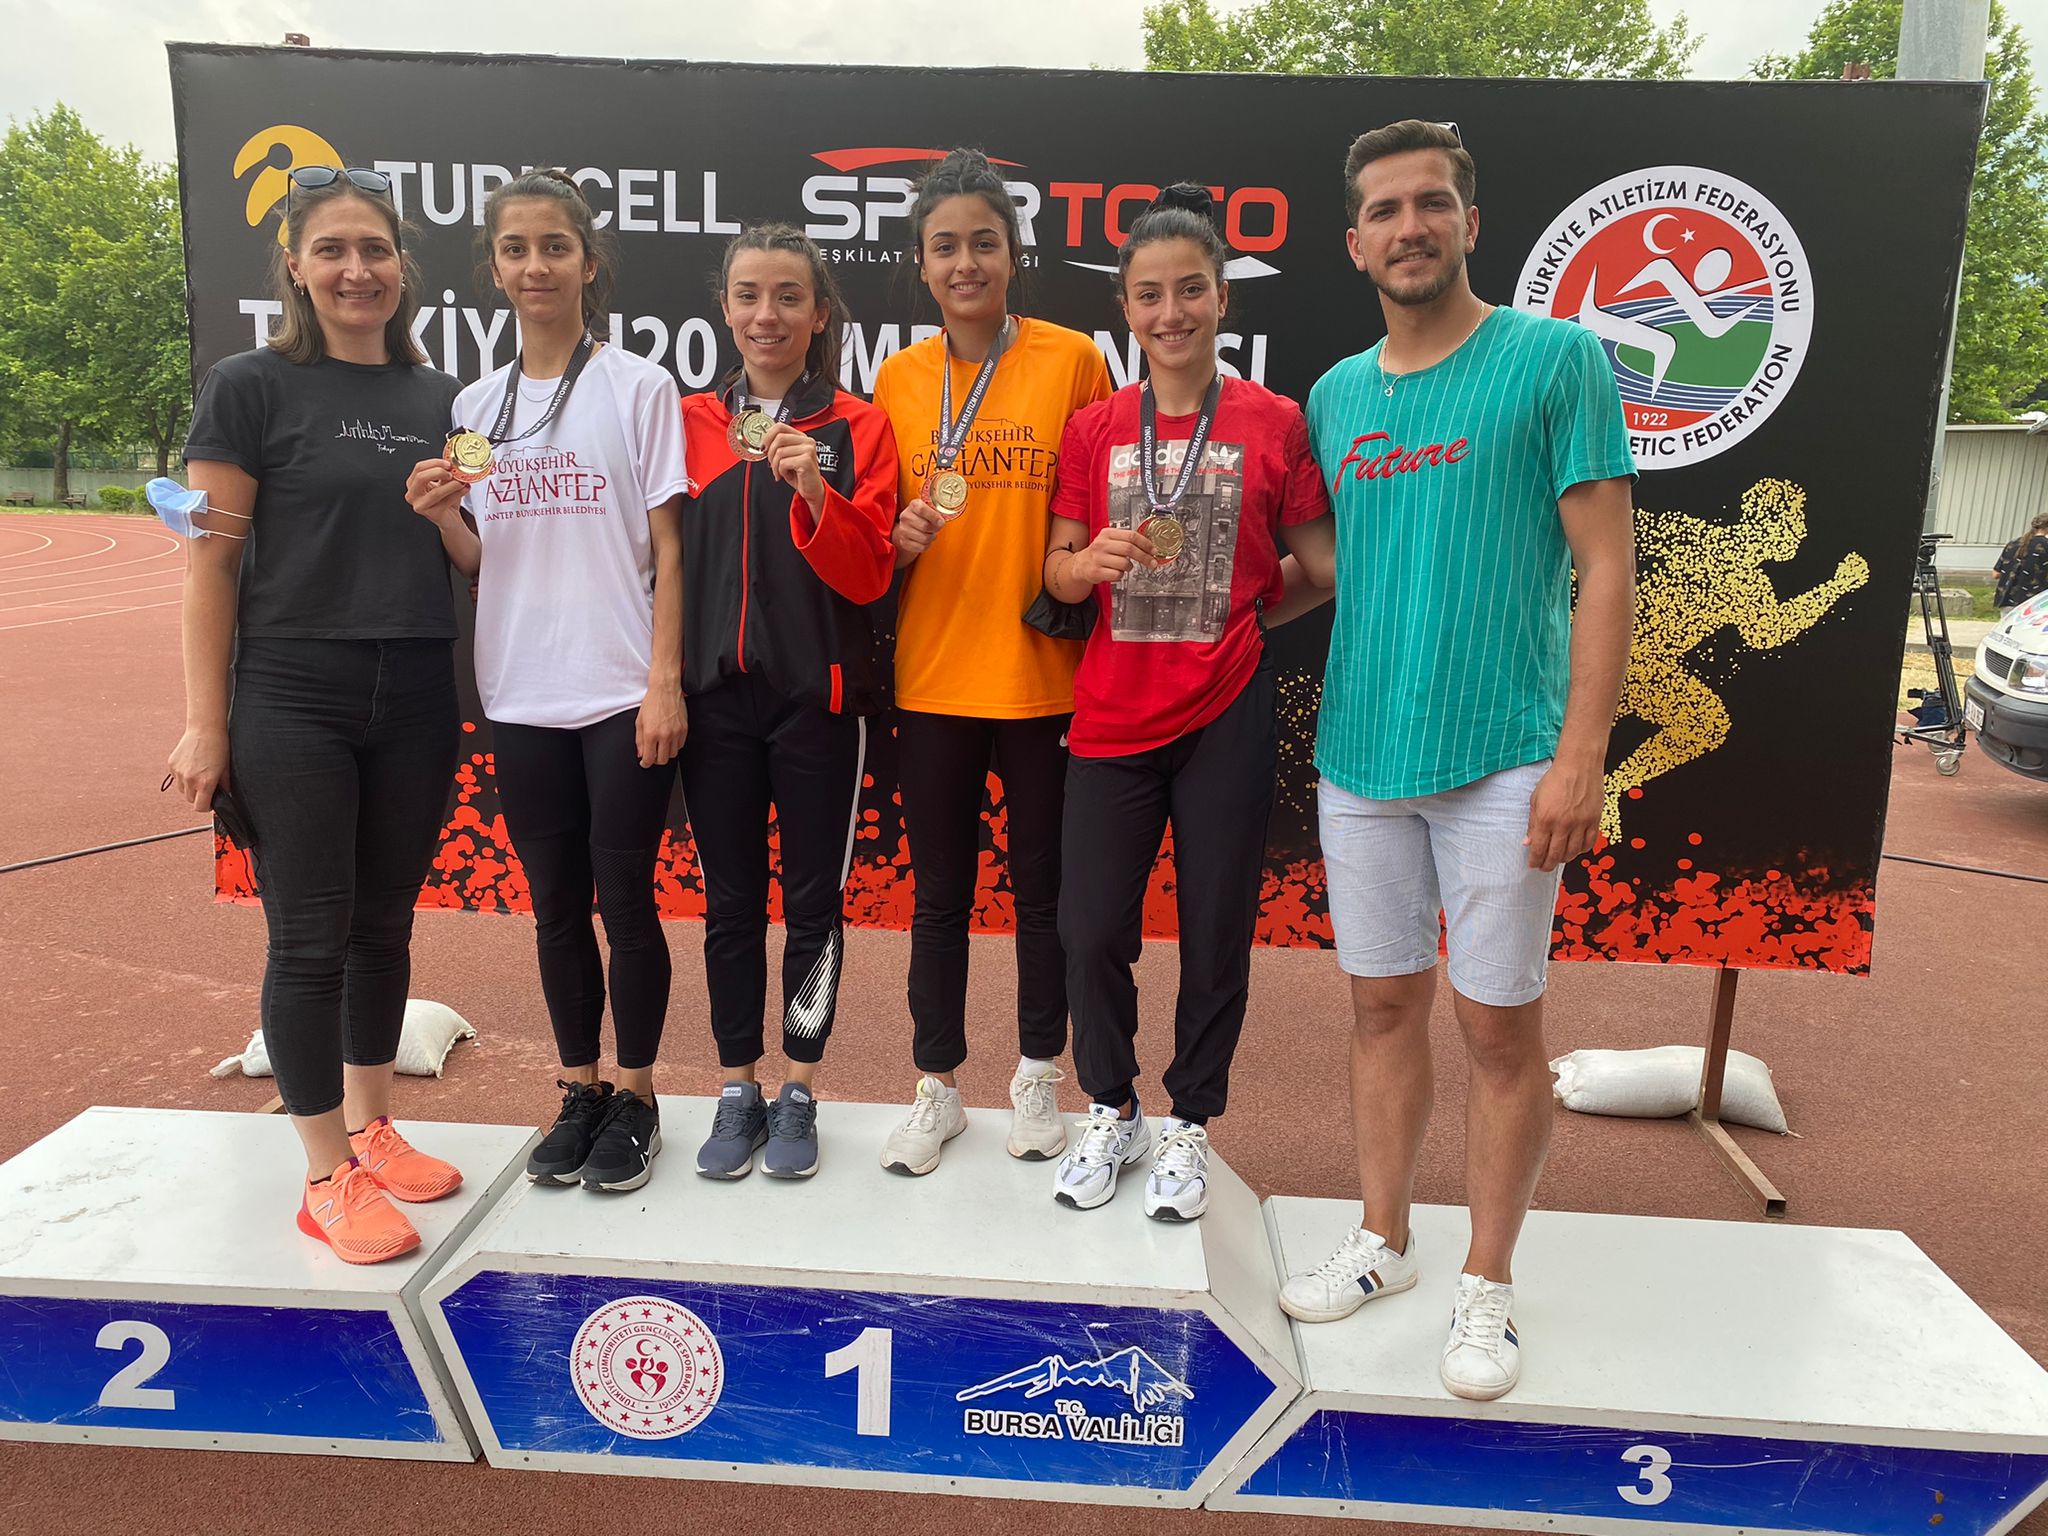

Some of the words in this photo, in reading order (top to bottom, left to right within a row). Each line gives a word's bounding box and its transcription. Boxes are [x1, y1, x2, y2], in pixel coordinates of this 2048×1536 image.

[373, 160, 741, 235] TURCELL
[819, 246, 903, 265] EŞKİLAT
[1527, 220, 1586, 306] TÜRKİYE
[1587, 178, 1687, 227] ATLETİZM
[1694, 183, 1800, 313] FEDERASYONU
[239, 289, 524, 380] TKİY
[608, 311, 719, 390] 20
[974, 359, 994, 398] FEDERASYONU
[1682, 343, 1793, 452] FEDERATION
[931, 425, 1036, 446] BÜKŞEHİR
[1632, 411, 1669, 427] 1922
[1144, 425, 1152, 469] FEDERASYONU
[1189, 415, 1209, 462] FEDERASYONU
[912, 444, 1058, 480] GAİANTEP
[1333, 430, 1471, 496] Future
[485, 473, 607, 508] AZİANTEP
[967, 480, 1013, 490] YÜKŞEHİR
[633, 1325, 674, 1340] GENÇLİK
[673, 1337, 683, 1349] VE
[94, 1320, 176, 1411] 2
[602, 1328, 633, 1379] CUMHURİYETİ
[680, 1349, 692, 1373] SPOR
[603, 1379, 636, 1408] TÜRKİYE
[658, 1374, 692, 1410] BAKANLIĞI
[825, 1327, 893, 1437] 1
[966, 1410, 1061, 1438] BURSA
[1069, 1415, 1182, 1444] VALİLİĞİ
[1617, 1445, 1674, 1507] 3
